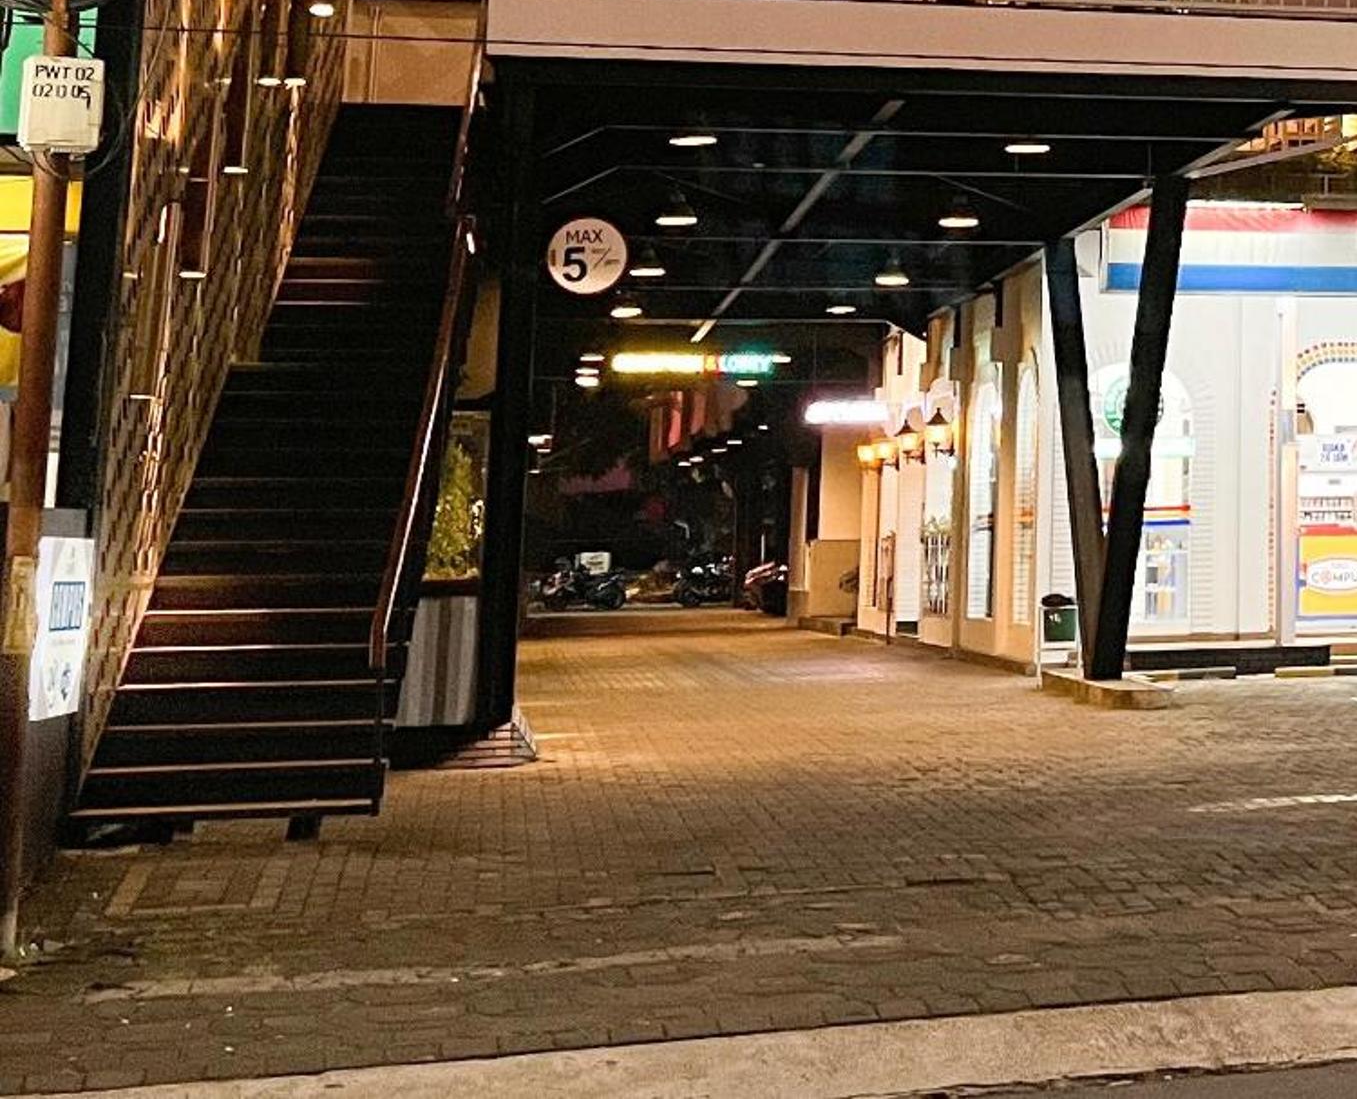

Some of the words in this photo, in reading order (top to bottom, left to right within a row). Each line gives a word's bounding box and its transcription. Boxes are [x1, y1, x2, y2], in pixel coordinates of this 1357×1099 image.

[35, 64, 72, 79] PWT
[75, 67, 95, 81] 02
[566, 229, 603, 244] MAX
[563, 246, 587, 282] 5
